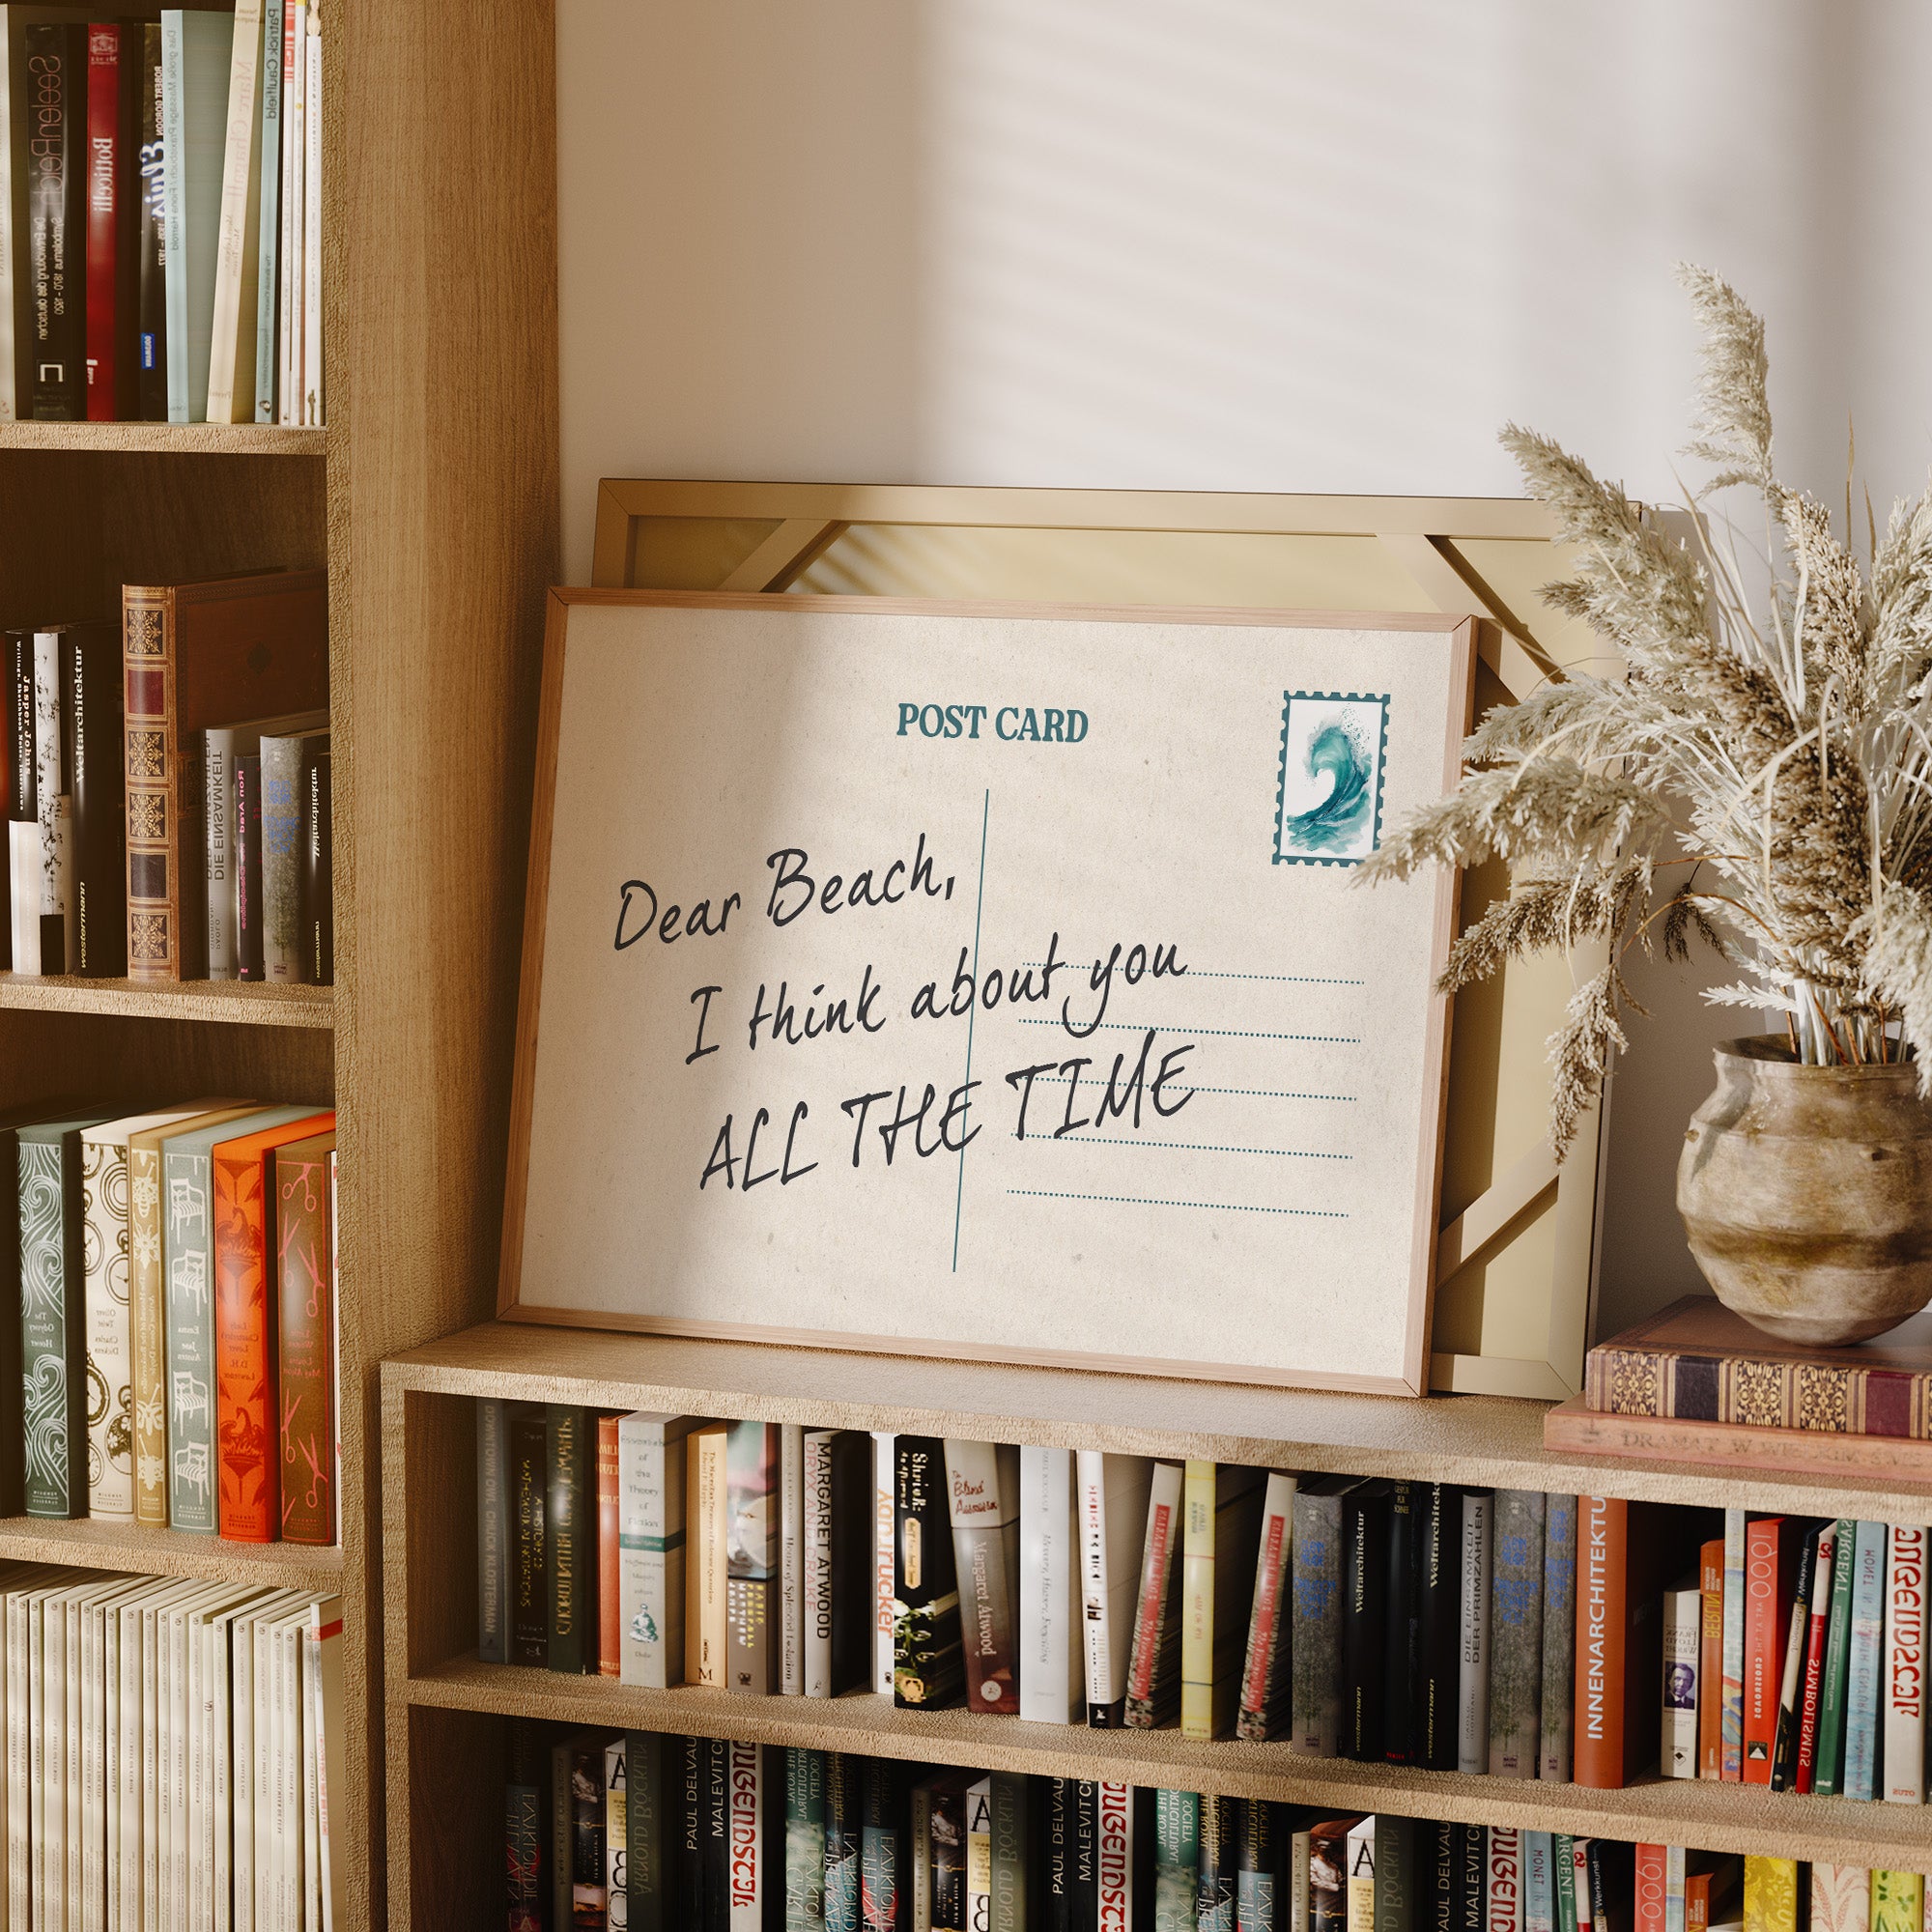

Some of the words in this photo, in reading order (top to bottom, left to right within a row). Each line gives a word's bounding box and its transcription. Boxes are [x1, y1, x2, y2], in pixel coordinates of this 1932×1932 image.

[22, 676, 31, 725] Jasper
[73, 645, 84, 783] Weltarchitektur
[896, 702, 986, 739] POST
[995, 707, 1089, 743] CARD
[78, 881, 87, 968] westermann
[613, 879, 741, 951] Dear
[766, 833, 956, 927] Beach,
[685, 985, 722, 1065] I
[749, 964, 886, 1052] think
[910, 932, 1065, 1019] about
[1062, 941, 1188, 1037] you
[699, 1101, 819, 1192] ALL
[840, 1081, 982, 1168] THE
[1006, 1029, 1196, 1141] TIME
[485, 1405, 495, 1477] DOWNTOWN
[806, 1441, 817, 1492] ORYX
[485, 1479, 495, 1504] OWL
[806, 1499, 817, 1540] AND
[816, 1442, 830, 1550] MARGARET
[485, 1511, 496, 1550] CHUCK
[1355, 1510, 1364, 1613] Weltarchitektur
[1430, 1482, 1440, 1588] Weltarchitekt
[1473, 1505, 1483, 1621] PRIMZAHLEN
[484, 1554, 496, 1633] KLOSTERMAN
[806, 1547, 817, 1612] CRAKE
[817, 1557, 831, 1639] ATWOOD
[972, 1541, 990, 1601] Margaret
[1464, 1520, 1473, 1628] EINSAMKEIT
[979, 1605, 997, 1656] Atwood
[1587, 1495, 1607, 1740] INNENARCHITEKTU
[686, 1736, 697, 1802] DELVAU
[686, 1808, 697, 1851] PAUL
[733, 1739, 756, 1908] JUGENDSTIL
[1052, 1777, 1064, 1845] DELVAU
[1052, 1851, 1064, 1894] PAUL
[1101, 1782, 1126, 1932] JUGENDST
[1438, 1822, 1450, 1890] DELVAU
[1533, 1849, 1544, 1886] MONET
[1558, 1834, 1574, 1899] ARGENT
[1574, 1852, 1585, 1867] 2
[1592, 1861, 1603, 1908] Werkkunst
[1636, 1856, 1662, 1919] 1900
[1438, 1896, 1450, 1932] PAUL
[1533, 1890, 1545, 1902] IN
